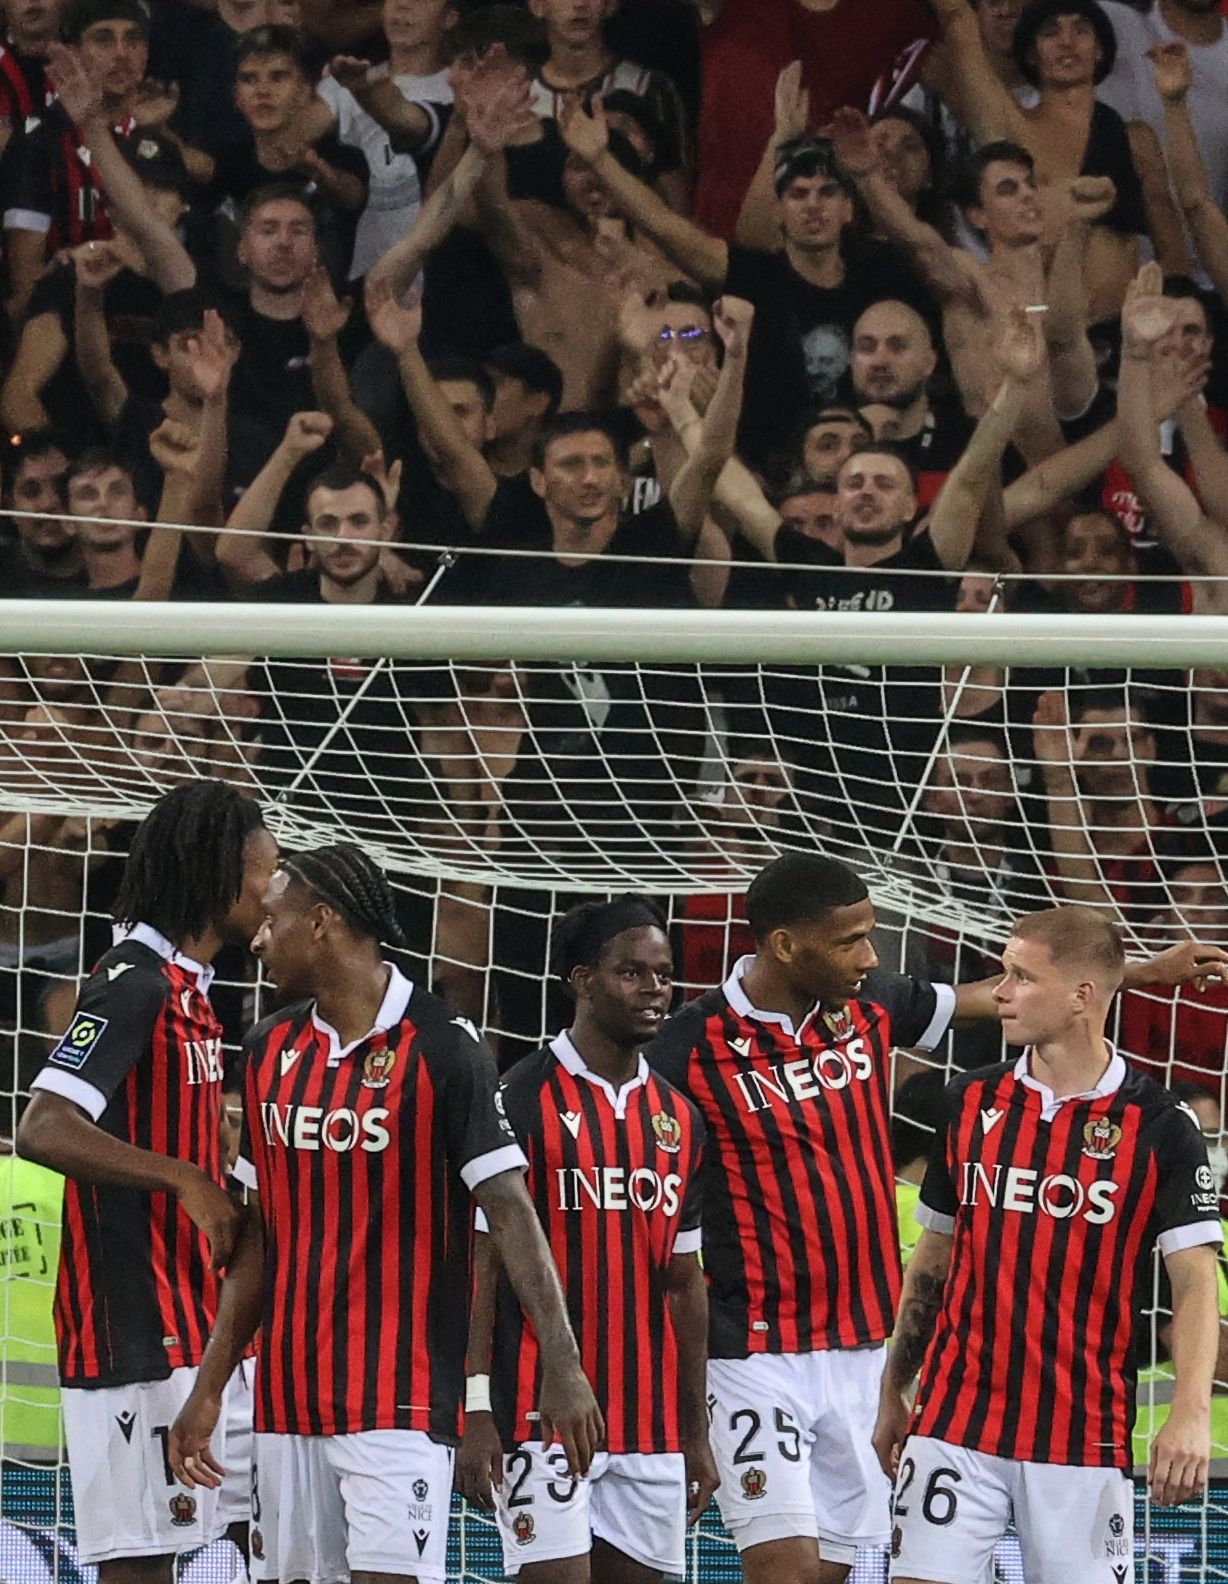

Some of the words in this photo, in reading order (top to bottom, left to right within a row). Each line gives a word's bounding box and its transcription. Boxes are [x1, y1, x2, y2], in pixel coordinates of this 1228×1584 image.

[731, 1038, 872, 1113] INEOS
[260, 1102, 390, 1153] INEOS
[555, 1166, 682, 1217] INEOS
[960, 1162, 1119, 1225] INEOS
[731, 1406, 801, 1465] 25
[506, 1450, 578, 1508] 23
[894, 1457, 962, 1526] 26
